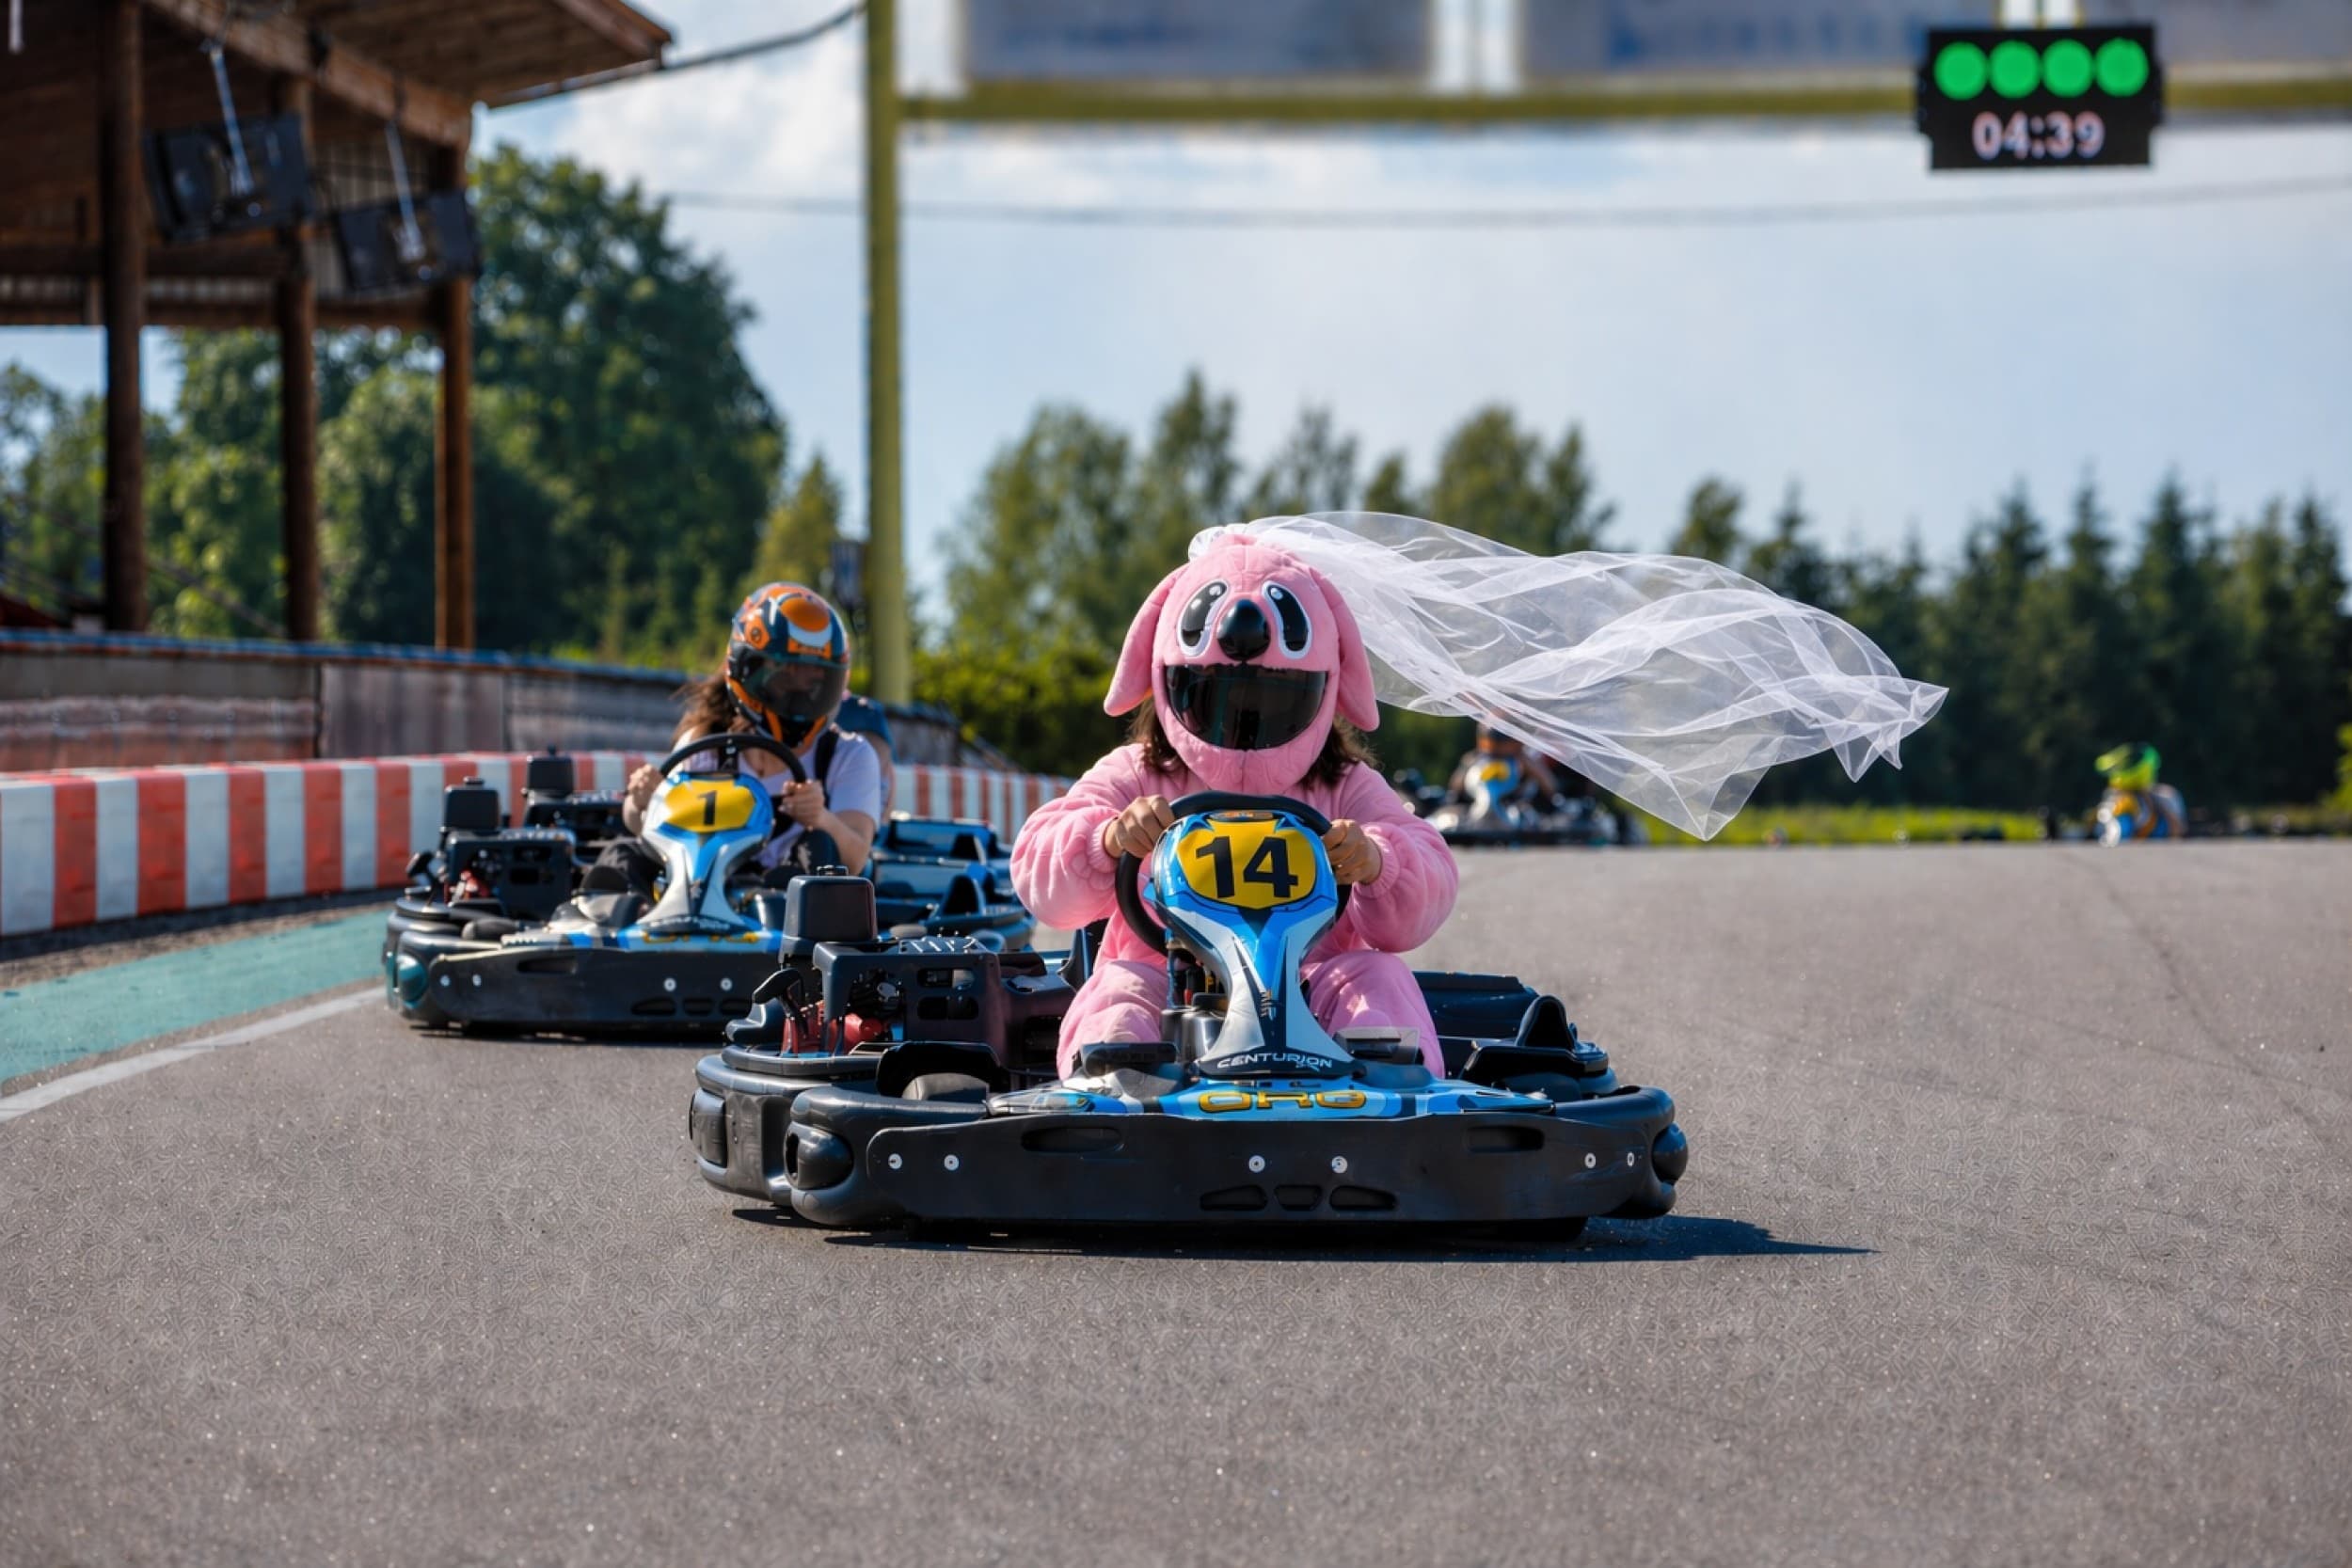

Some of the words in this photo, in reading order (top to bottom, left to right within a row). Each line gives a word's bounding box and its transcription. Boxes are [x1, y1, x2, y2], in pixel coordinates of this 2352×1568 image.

[1972, 110, 2106, 160] 04:39
[697, 789, 717, 827] 1
[1195, 835, 1299, 899] 14
[1216, 1052, 1333, 1069] CENTURION
